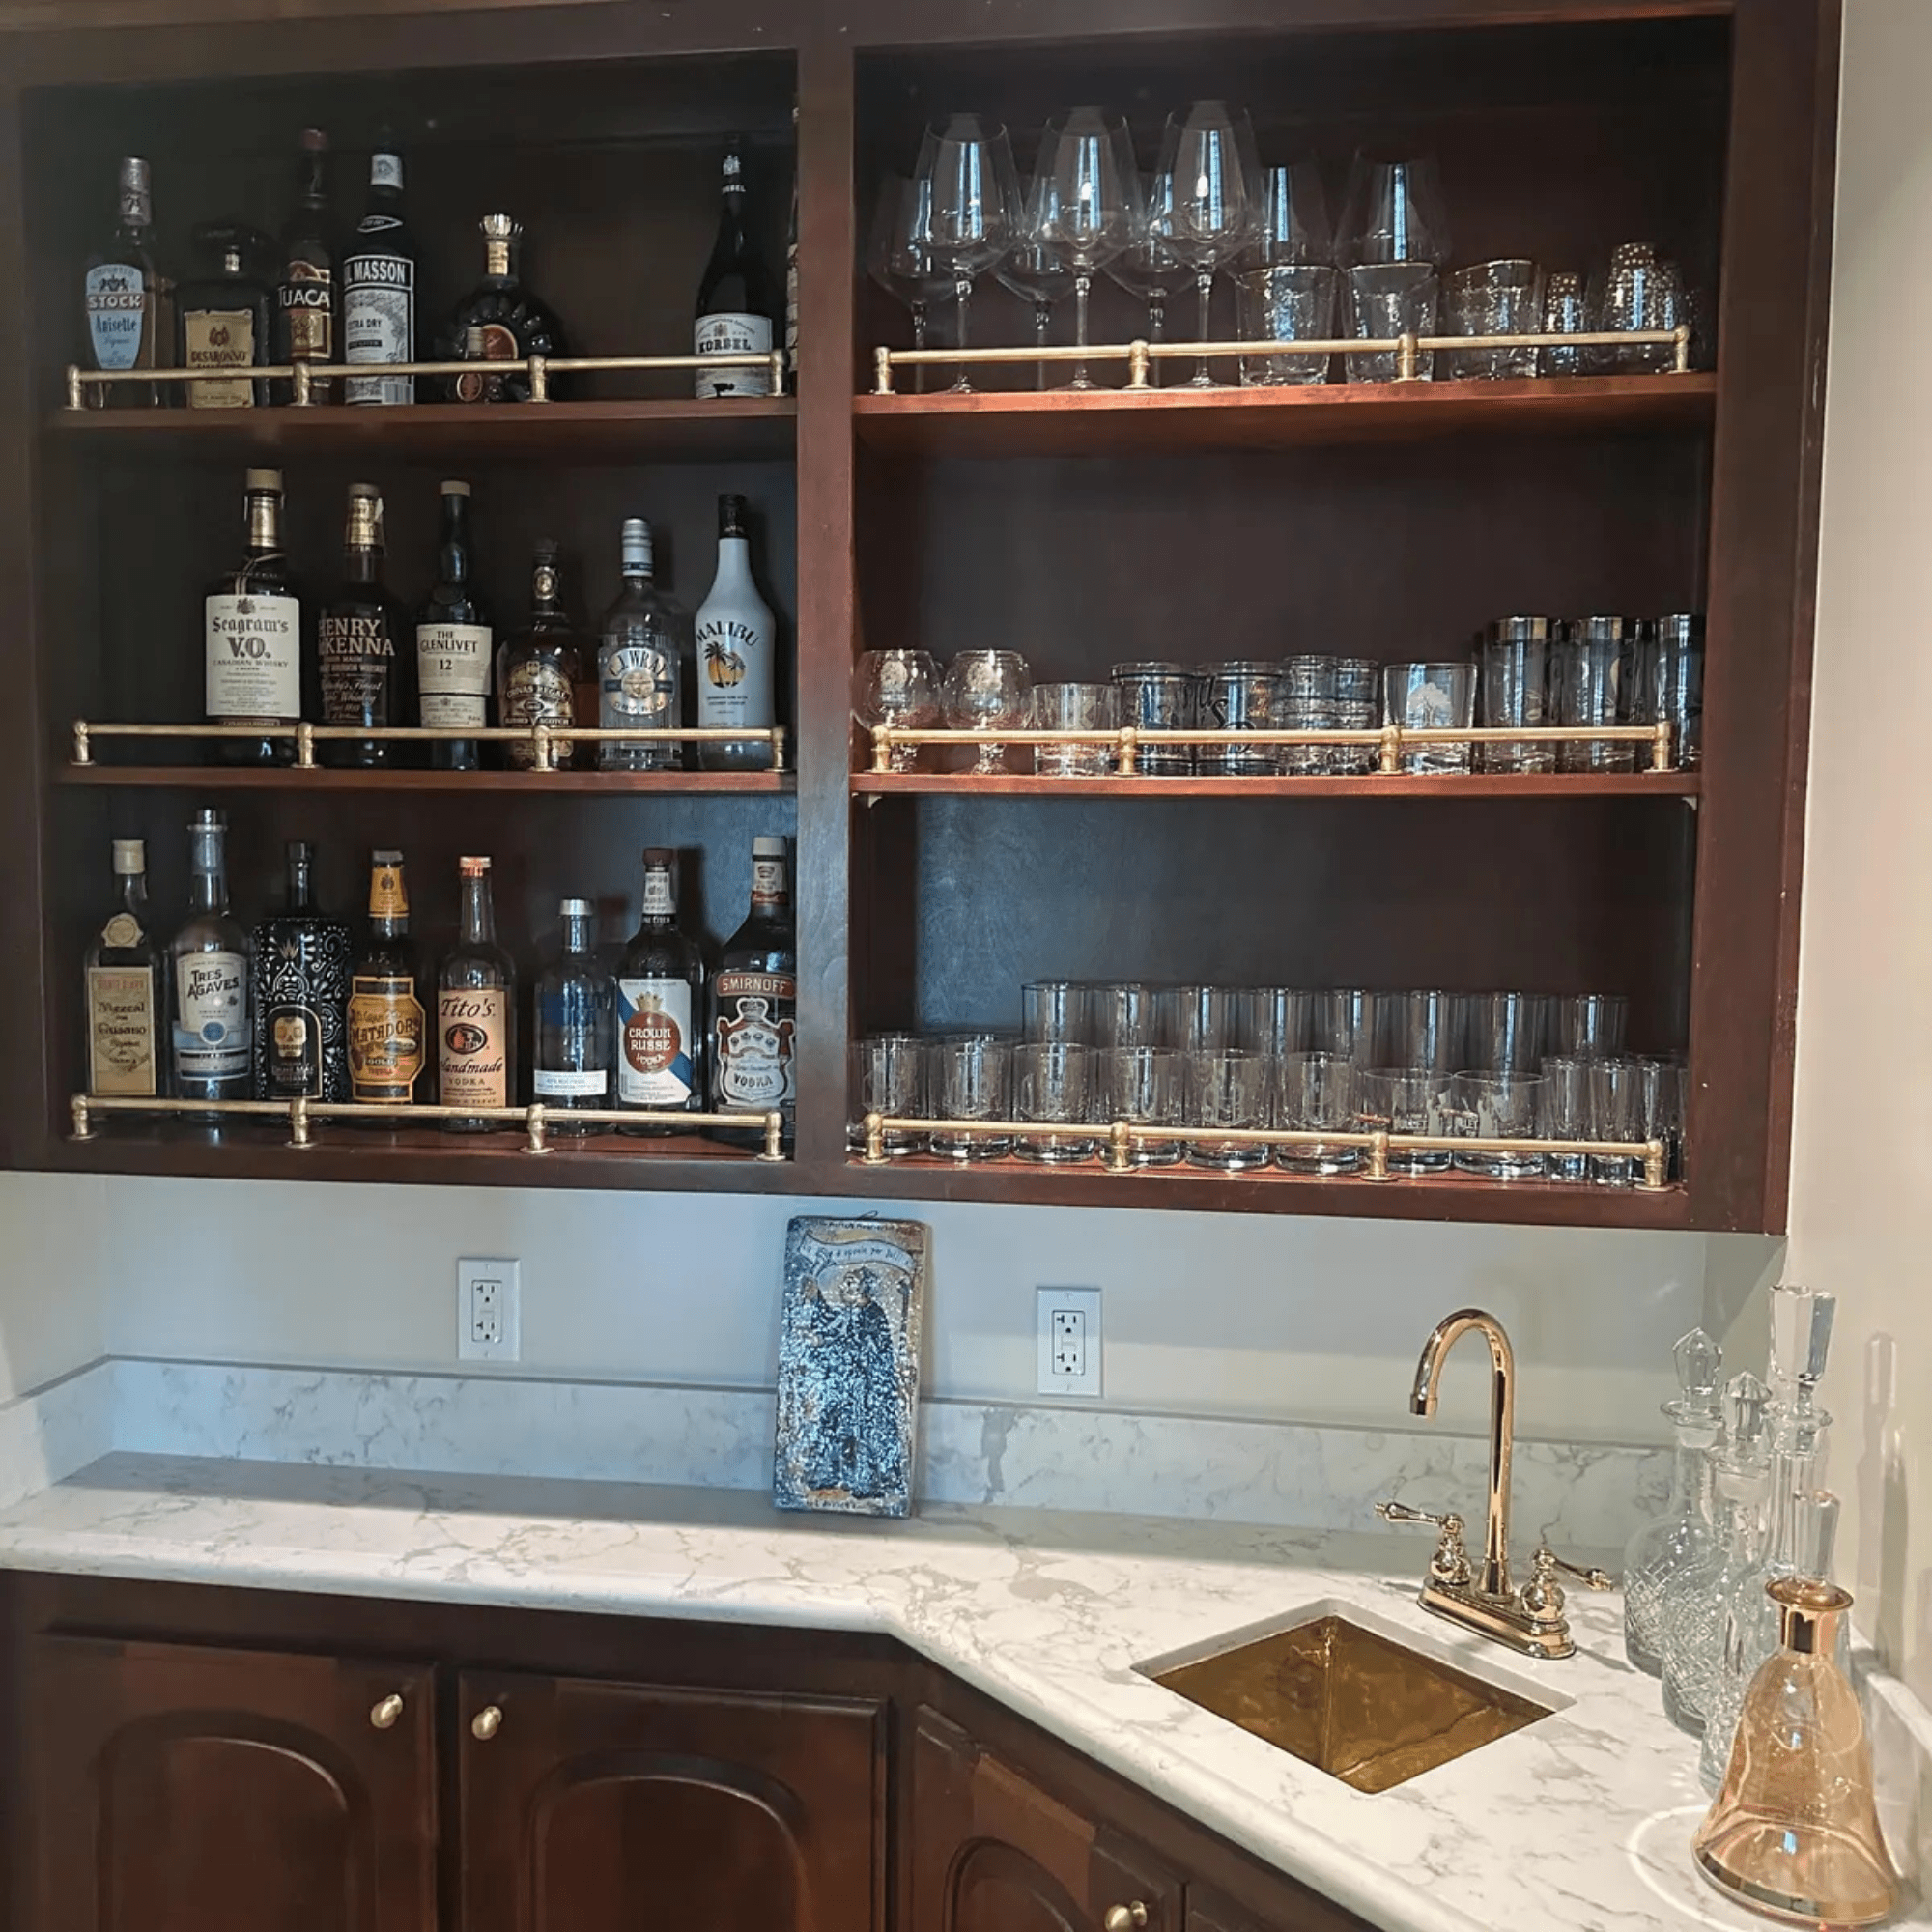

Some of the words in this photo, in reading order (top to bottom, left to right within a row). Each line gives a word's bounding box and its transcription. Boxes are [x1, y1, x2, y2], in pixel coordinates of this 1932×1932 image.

[354, 260, 405, 283] MASSON
[88, 294, 142, 309] STOCK
[279, 286, 330, 308] TUACA
[698, 337, 752, 354] KORBEL
[212, 616, 289, 634] Seagram's
[319, 618, 381, 637] HENRY
[696, 621, 759, 646] MALIBU
[226, 636, 271, 659] V.O.
[420, 639, 478, 653] GLENLIVET
[440, 659, 452, 670] 12
[191, 969, 222, 983] TRES
[187, 977, 240, 1001] AGAVES
[722, 977, 786, 993] SMIRNOFF
[98, 1002, 145, 1013] Mezcal
[441, 996, 497, 1018] Tito's
[98, 1022, 146, 1035] Gusano
[629, 1027, 672, 1039] CROWN
[631, 1039, 671, 1051] RUSSE
[441, 1056, 503, 1074] Handmade
[734, 1072, 773, 1087] VODKA
